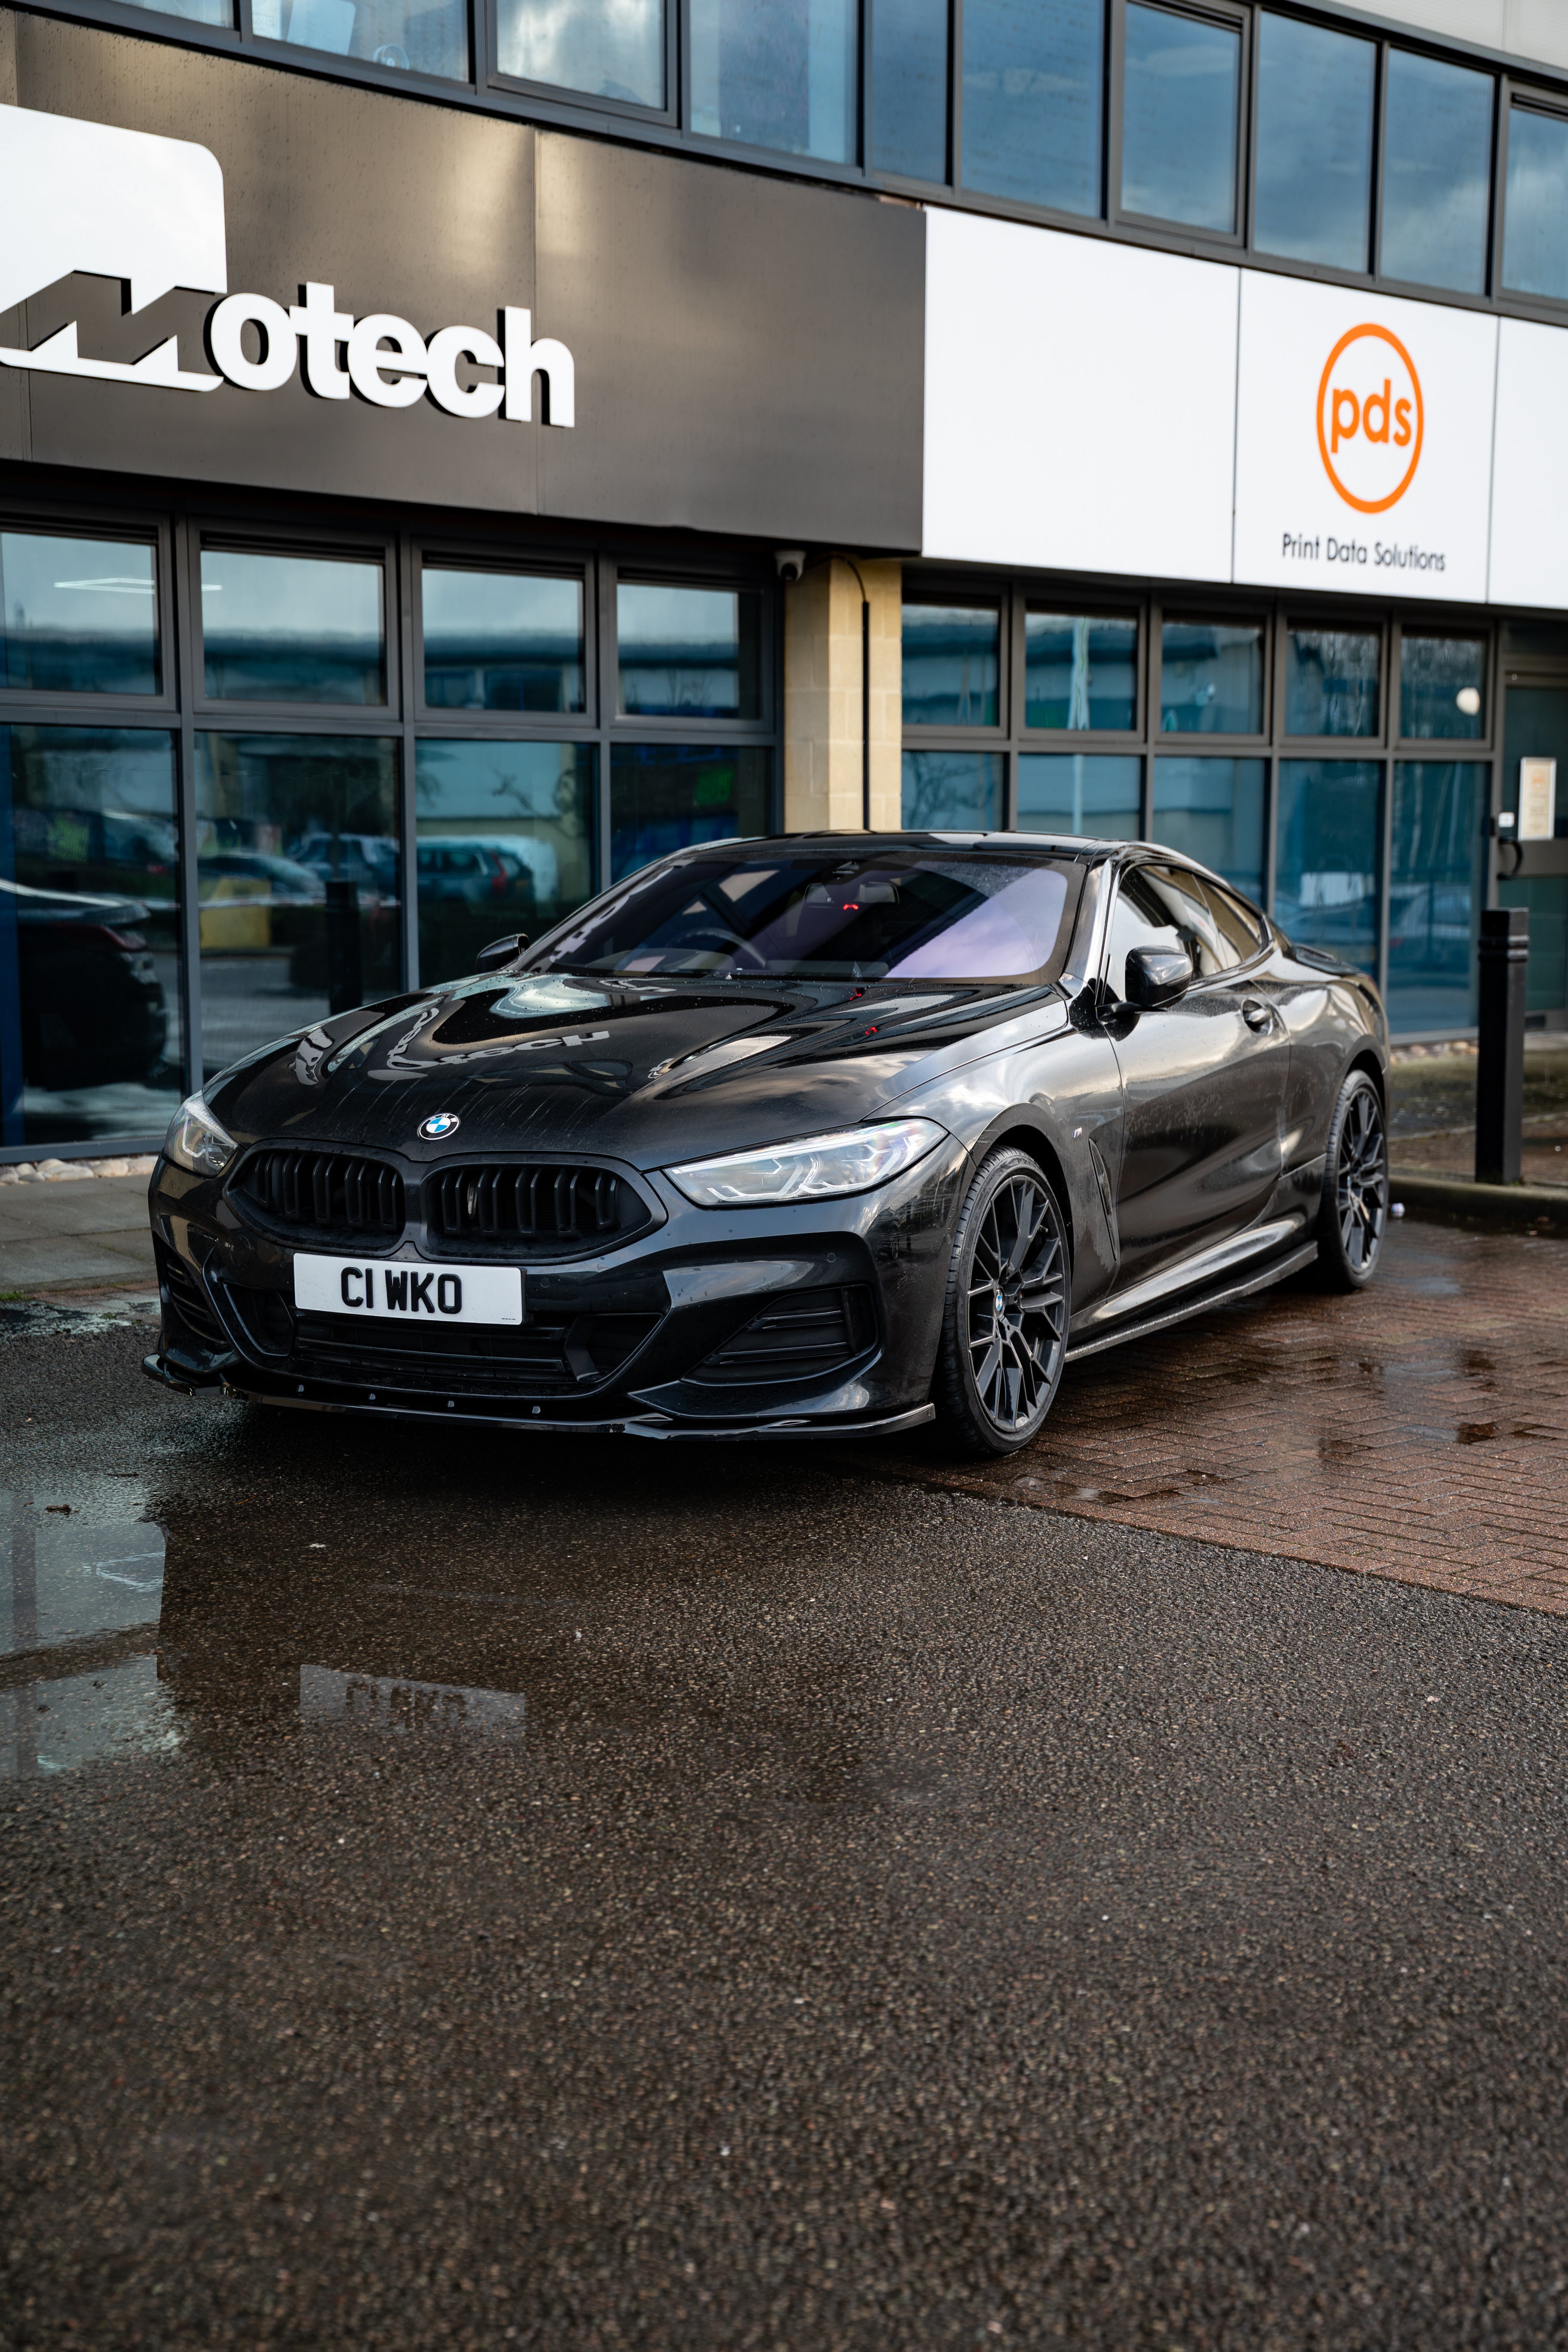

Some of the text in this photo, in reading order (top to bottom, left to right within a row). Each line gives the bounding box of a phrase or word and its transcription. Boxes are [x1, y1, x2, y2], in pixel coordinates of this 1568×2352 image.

[1331, 378, 1412, 453] pds
[1283, 533, 1445, 572] Print Data Solutions
[385, 1270, 462, 1314] WKO
